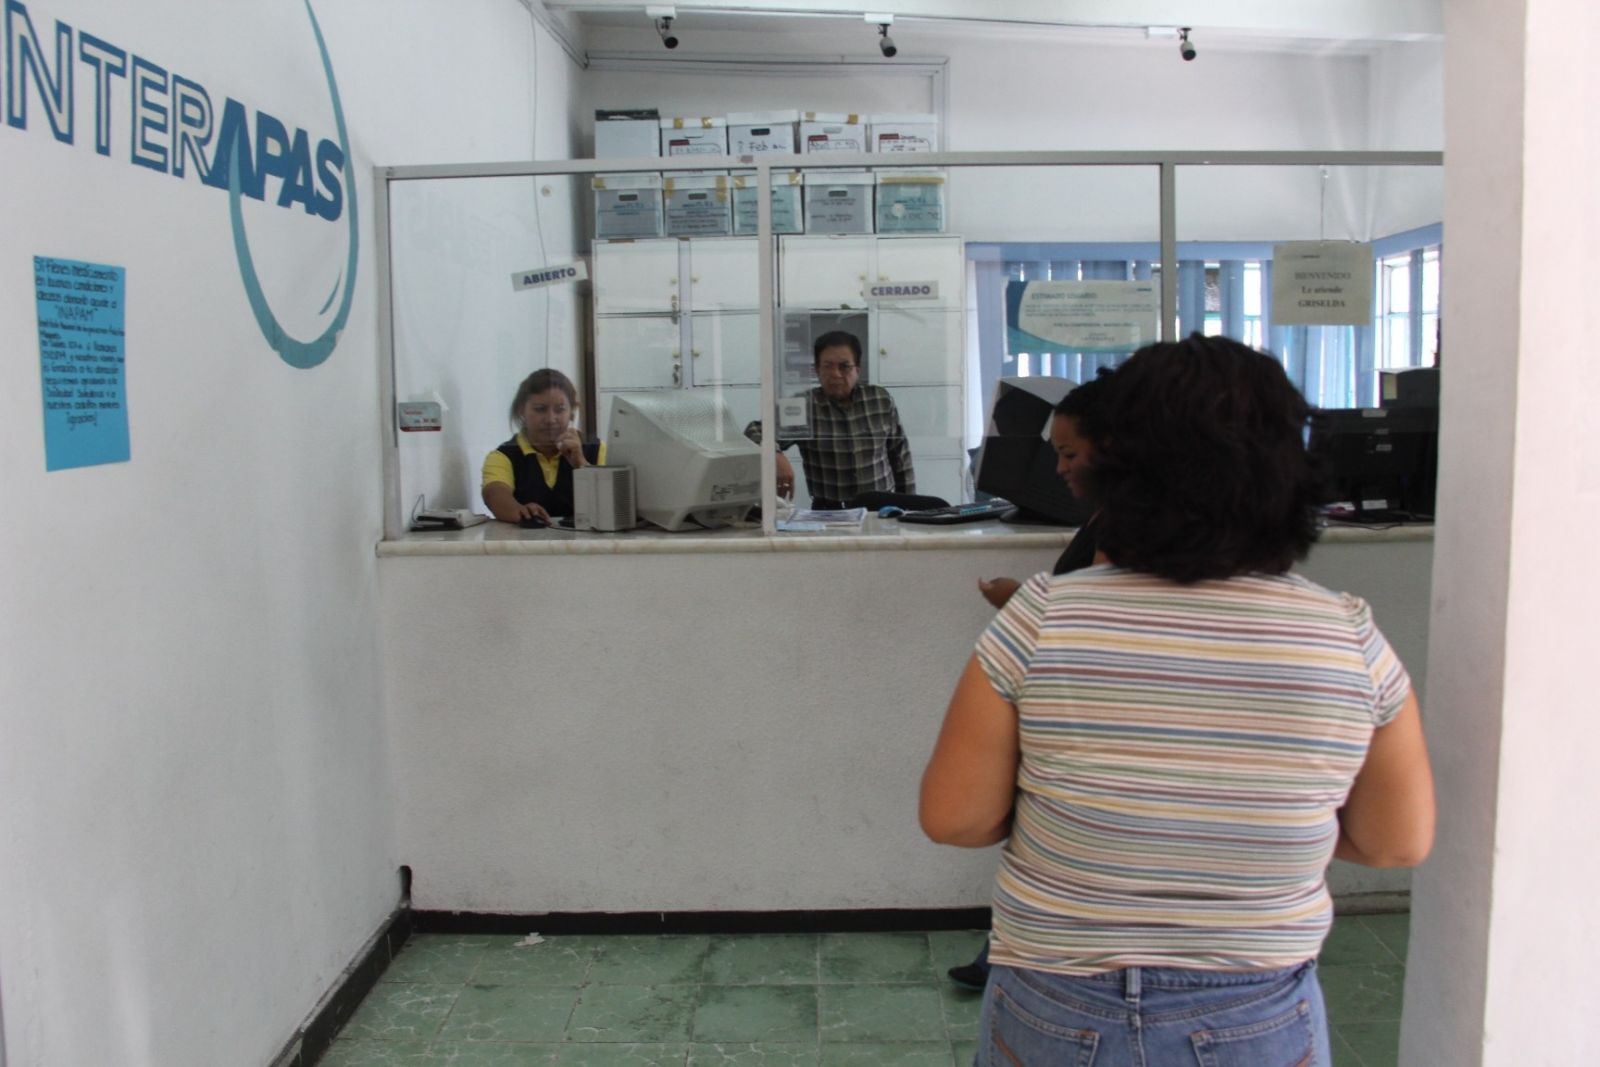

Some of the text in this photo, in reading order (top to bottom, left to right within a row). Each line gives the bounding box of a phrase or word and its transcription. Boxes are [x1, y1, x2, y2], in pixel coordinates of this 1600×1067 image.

[0, 0, 345, 221] NTERAPAS
[523, 267, 576, 285] ABIERTO
[1294, 272, 1351, 280] BIENVENIDO
[871, 285, 930, 296] CERRADO
[1302, 286, 1343, 294] Le atiende
[1298, 299, 1346, 308] GRISELDA
